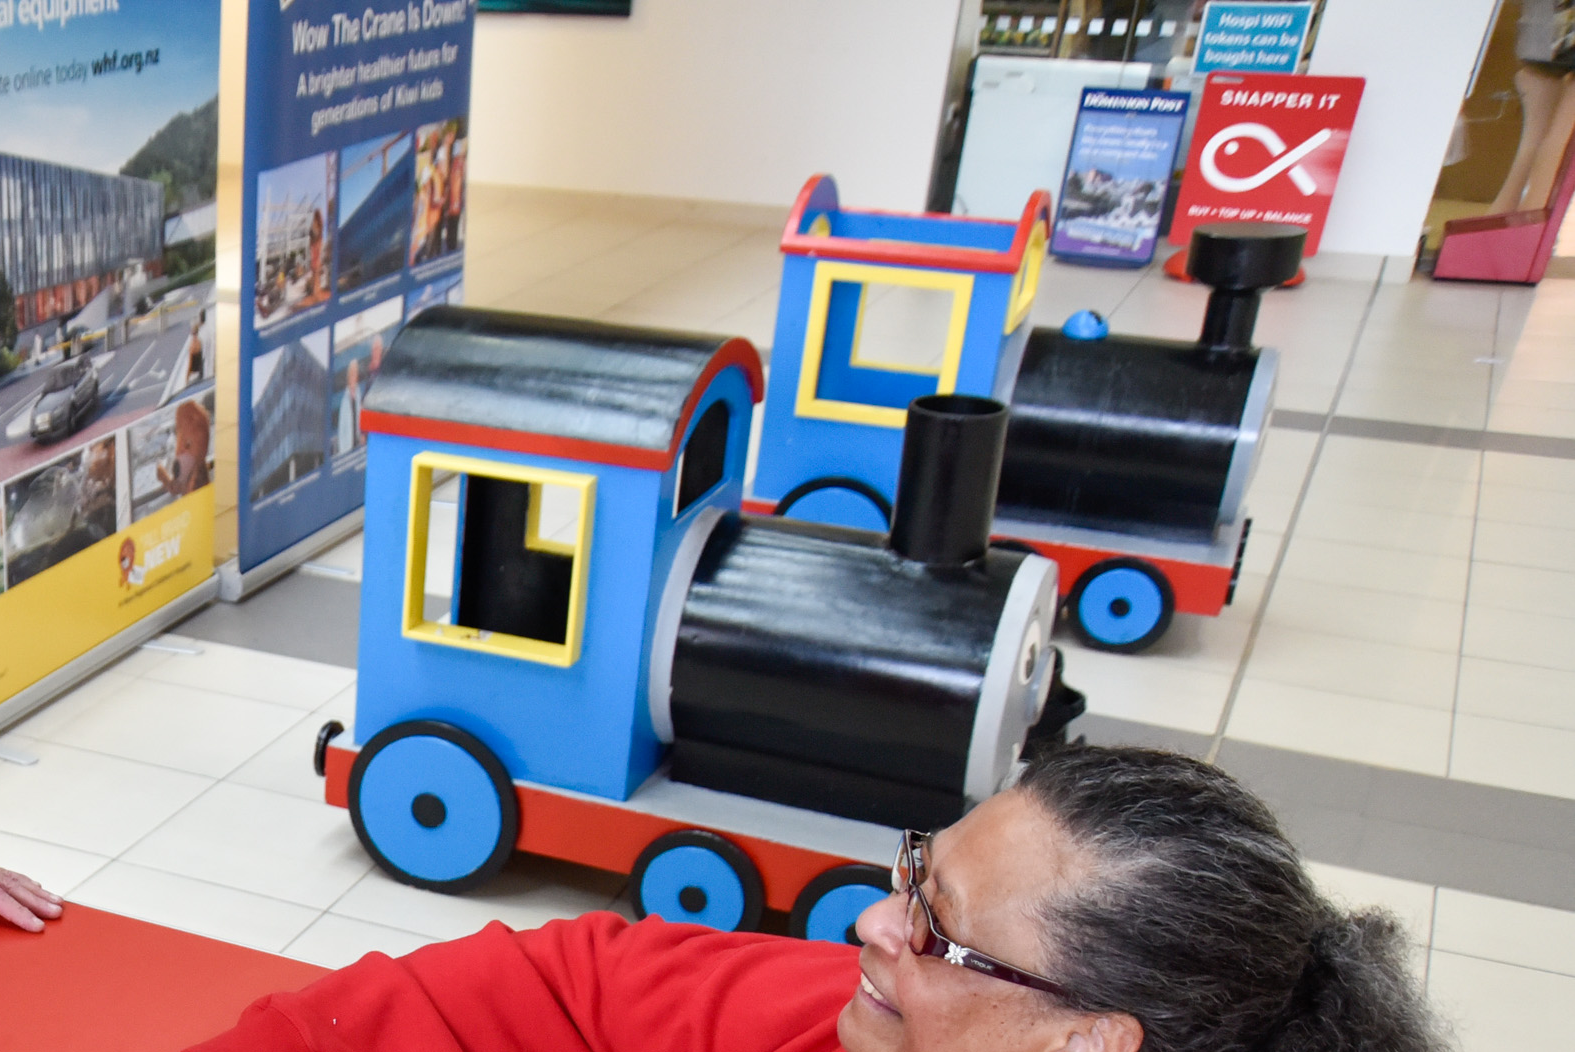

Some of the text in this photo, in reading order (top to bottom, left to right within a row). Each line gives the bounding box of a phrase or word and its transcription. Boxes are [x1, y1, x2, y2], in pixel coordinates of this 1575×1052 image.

[292, 0, 467, 56] Wow The Crane Is Down!
[1204, 32, 1299, 47] tokens can be
[1203, 48, 1290, 66] bought here
[13, 65, 53, 92] online
[55, 58, 89, 84] today
[91, 48, 160, 75] whf.org.nz
[296, 41, 459, 99] A brighter healthier future for
[311, 77, 444, 137] generations of Kiwi kids
[1150, 97, 1185, 113] POST
[1220, 89, 1341, 110] SNAPPER IT
[1187, 205, 1313, 224] BUY TOP UP BALANCE
